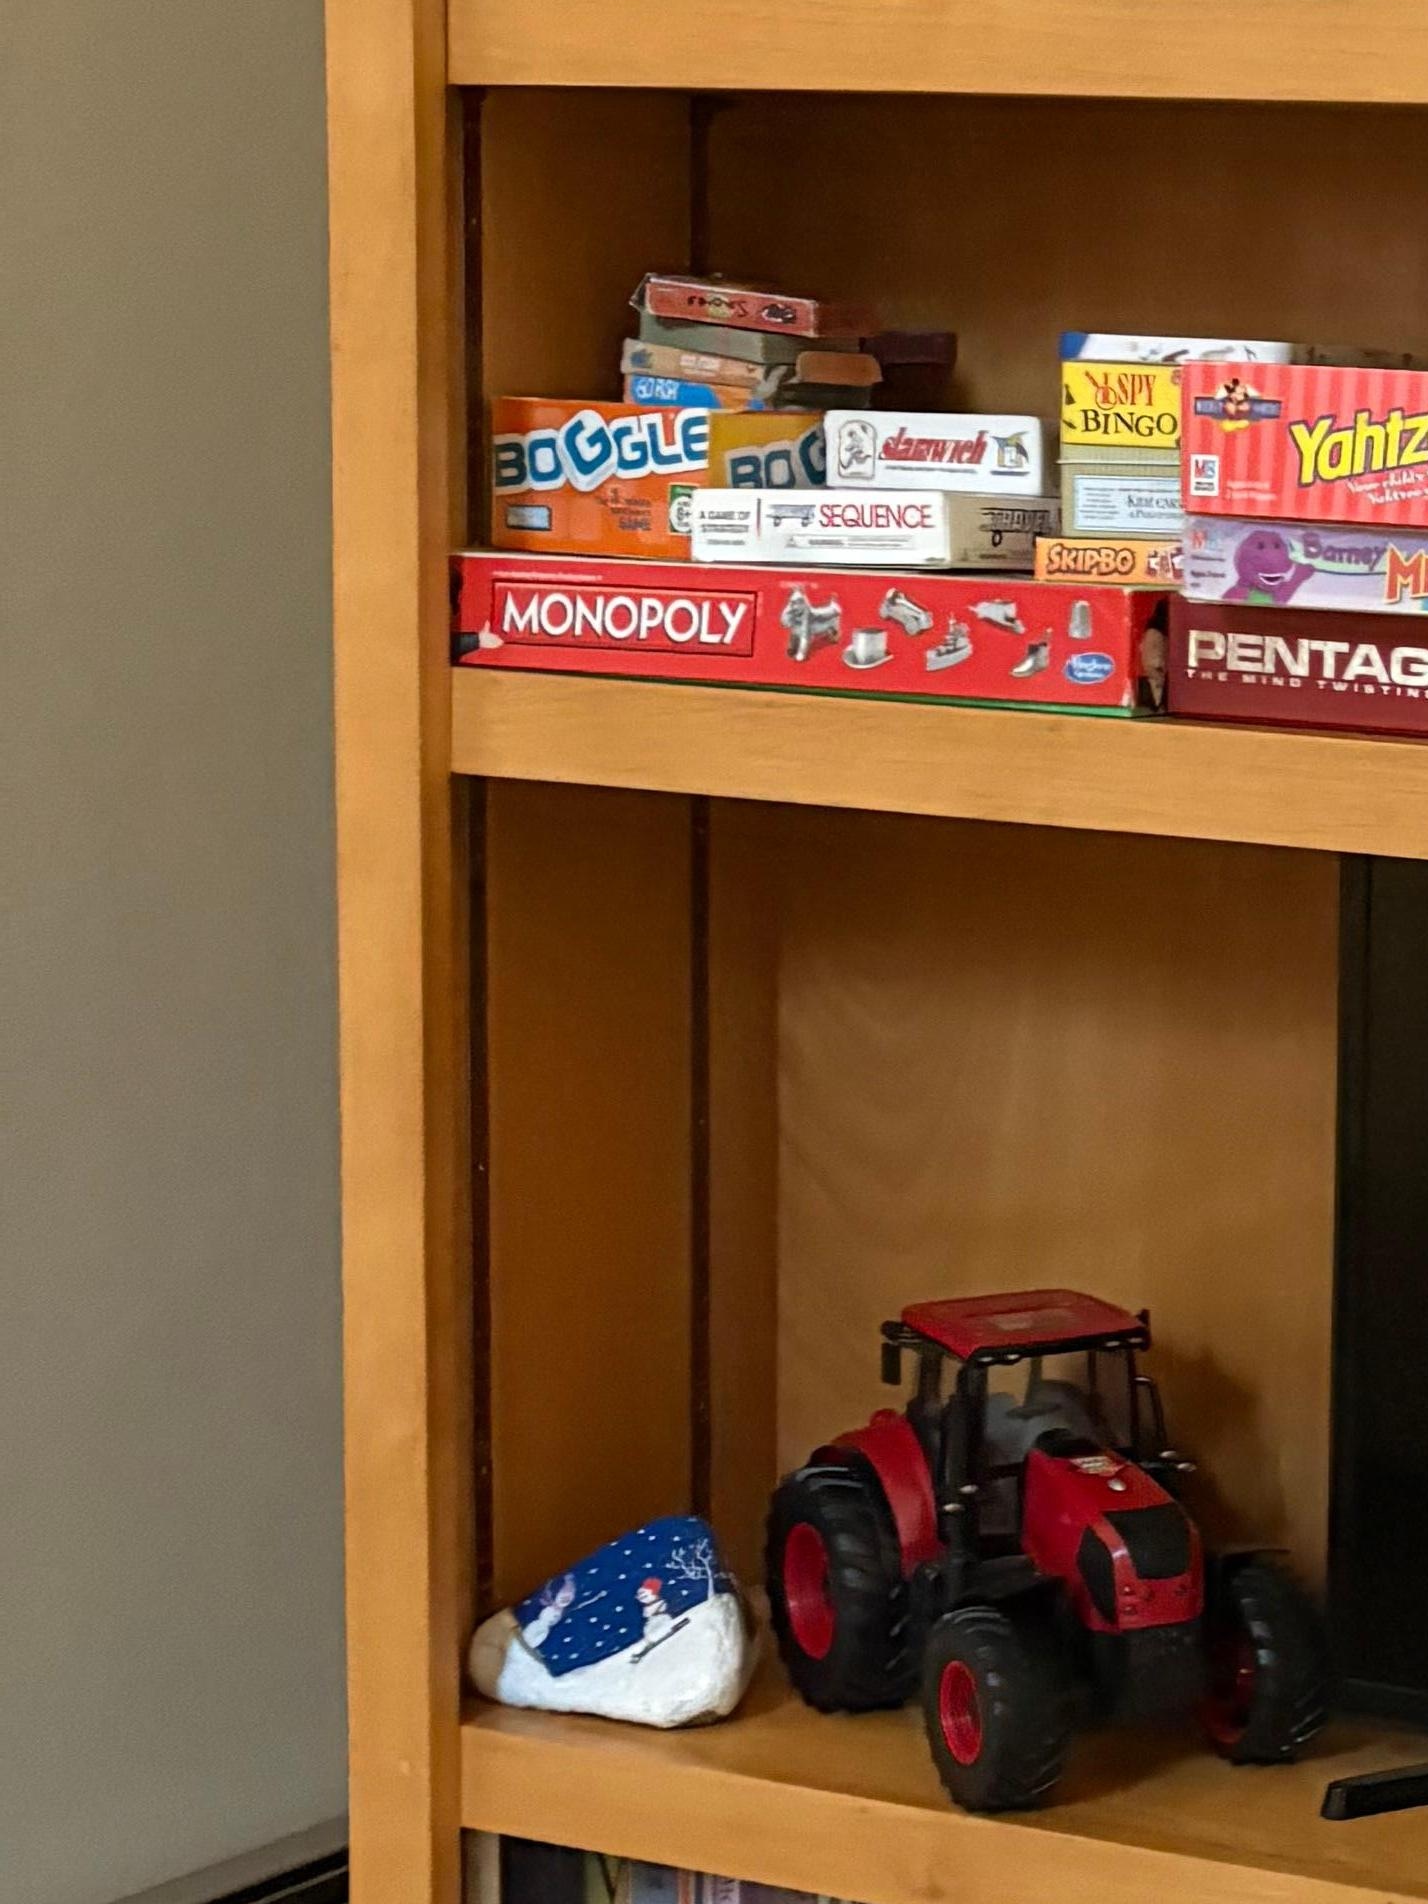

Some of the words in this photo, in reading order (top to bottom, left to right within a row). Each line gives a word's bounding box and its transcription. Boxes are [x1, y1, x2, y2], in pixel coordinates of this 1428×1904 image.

[1117, 373, 1157, 407] SPY
[1080, 408, 1178, 437] BINGO
[493, 408, 710, 494] BOGGLE
[818, 503, 935, 529] SEQUENCE
[1302, 535, 1388, 571] Barney
[502, 591, 748, 646] MONOPOLY
[1186, 668, 1228, 683] THE
[1241, 673, 1303, 688] MIND
